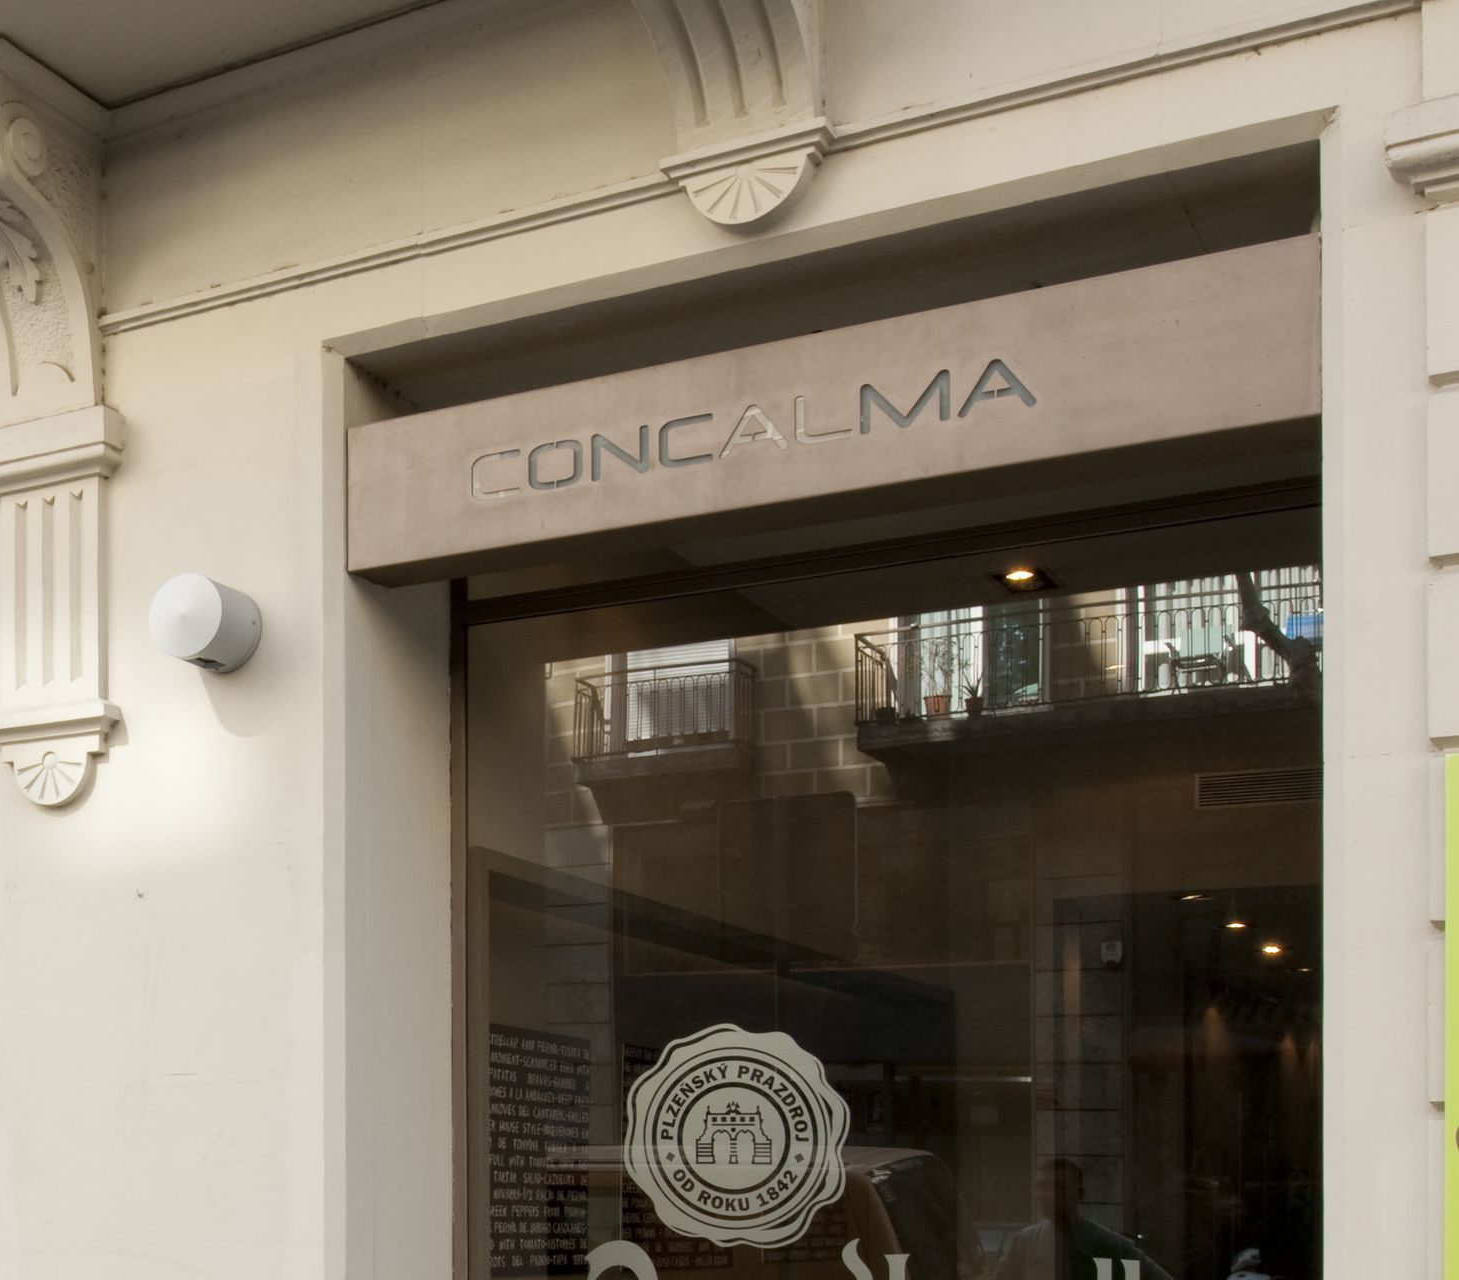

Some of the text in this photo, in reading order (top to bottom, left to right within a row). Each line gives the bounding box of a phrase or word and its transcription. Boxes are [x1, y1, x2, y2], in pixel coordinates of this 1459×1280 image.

[471, 358, 1037, 502] CONCALMA
[660, 1062, 729, 1141] PLZEŇSKÝ
[737, 1065, 810, 1143] PRAZDROJ
[672, 1168, 798, 1212] OD ROKU 1842
